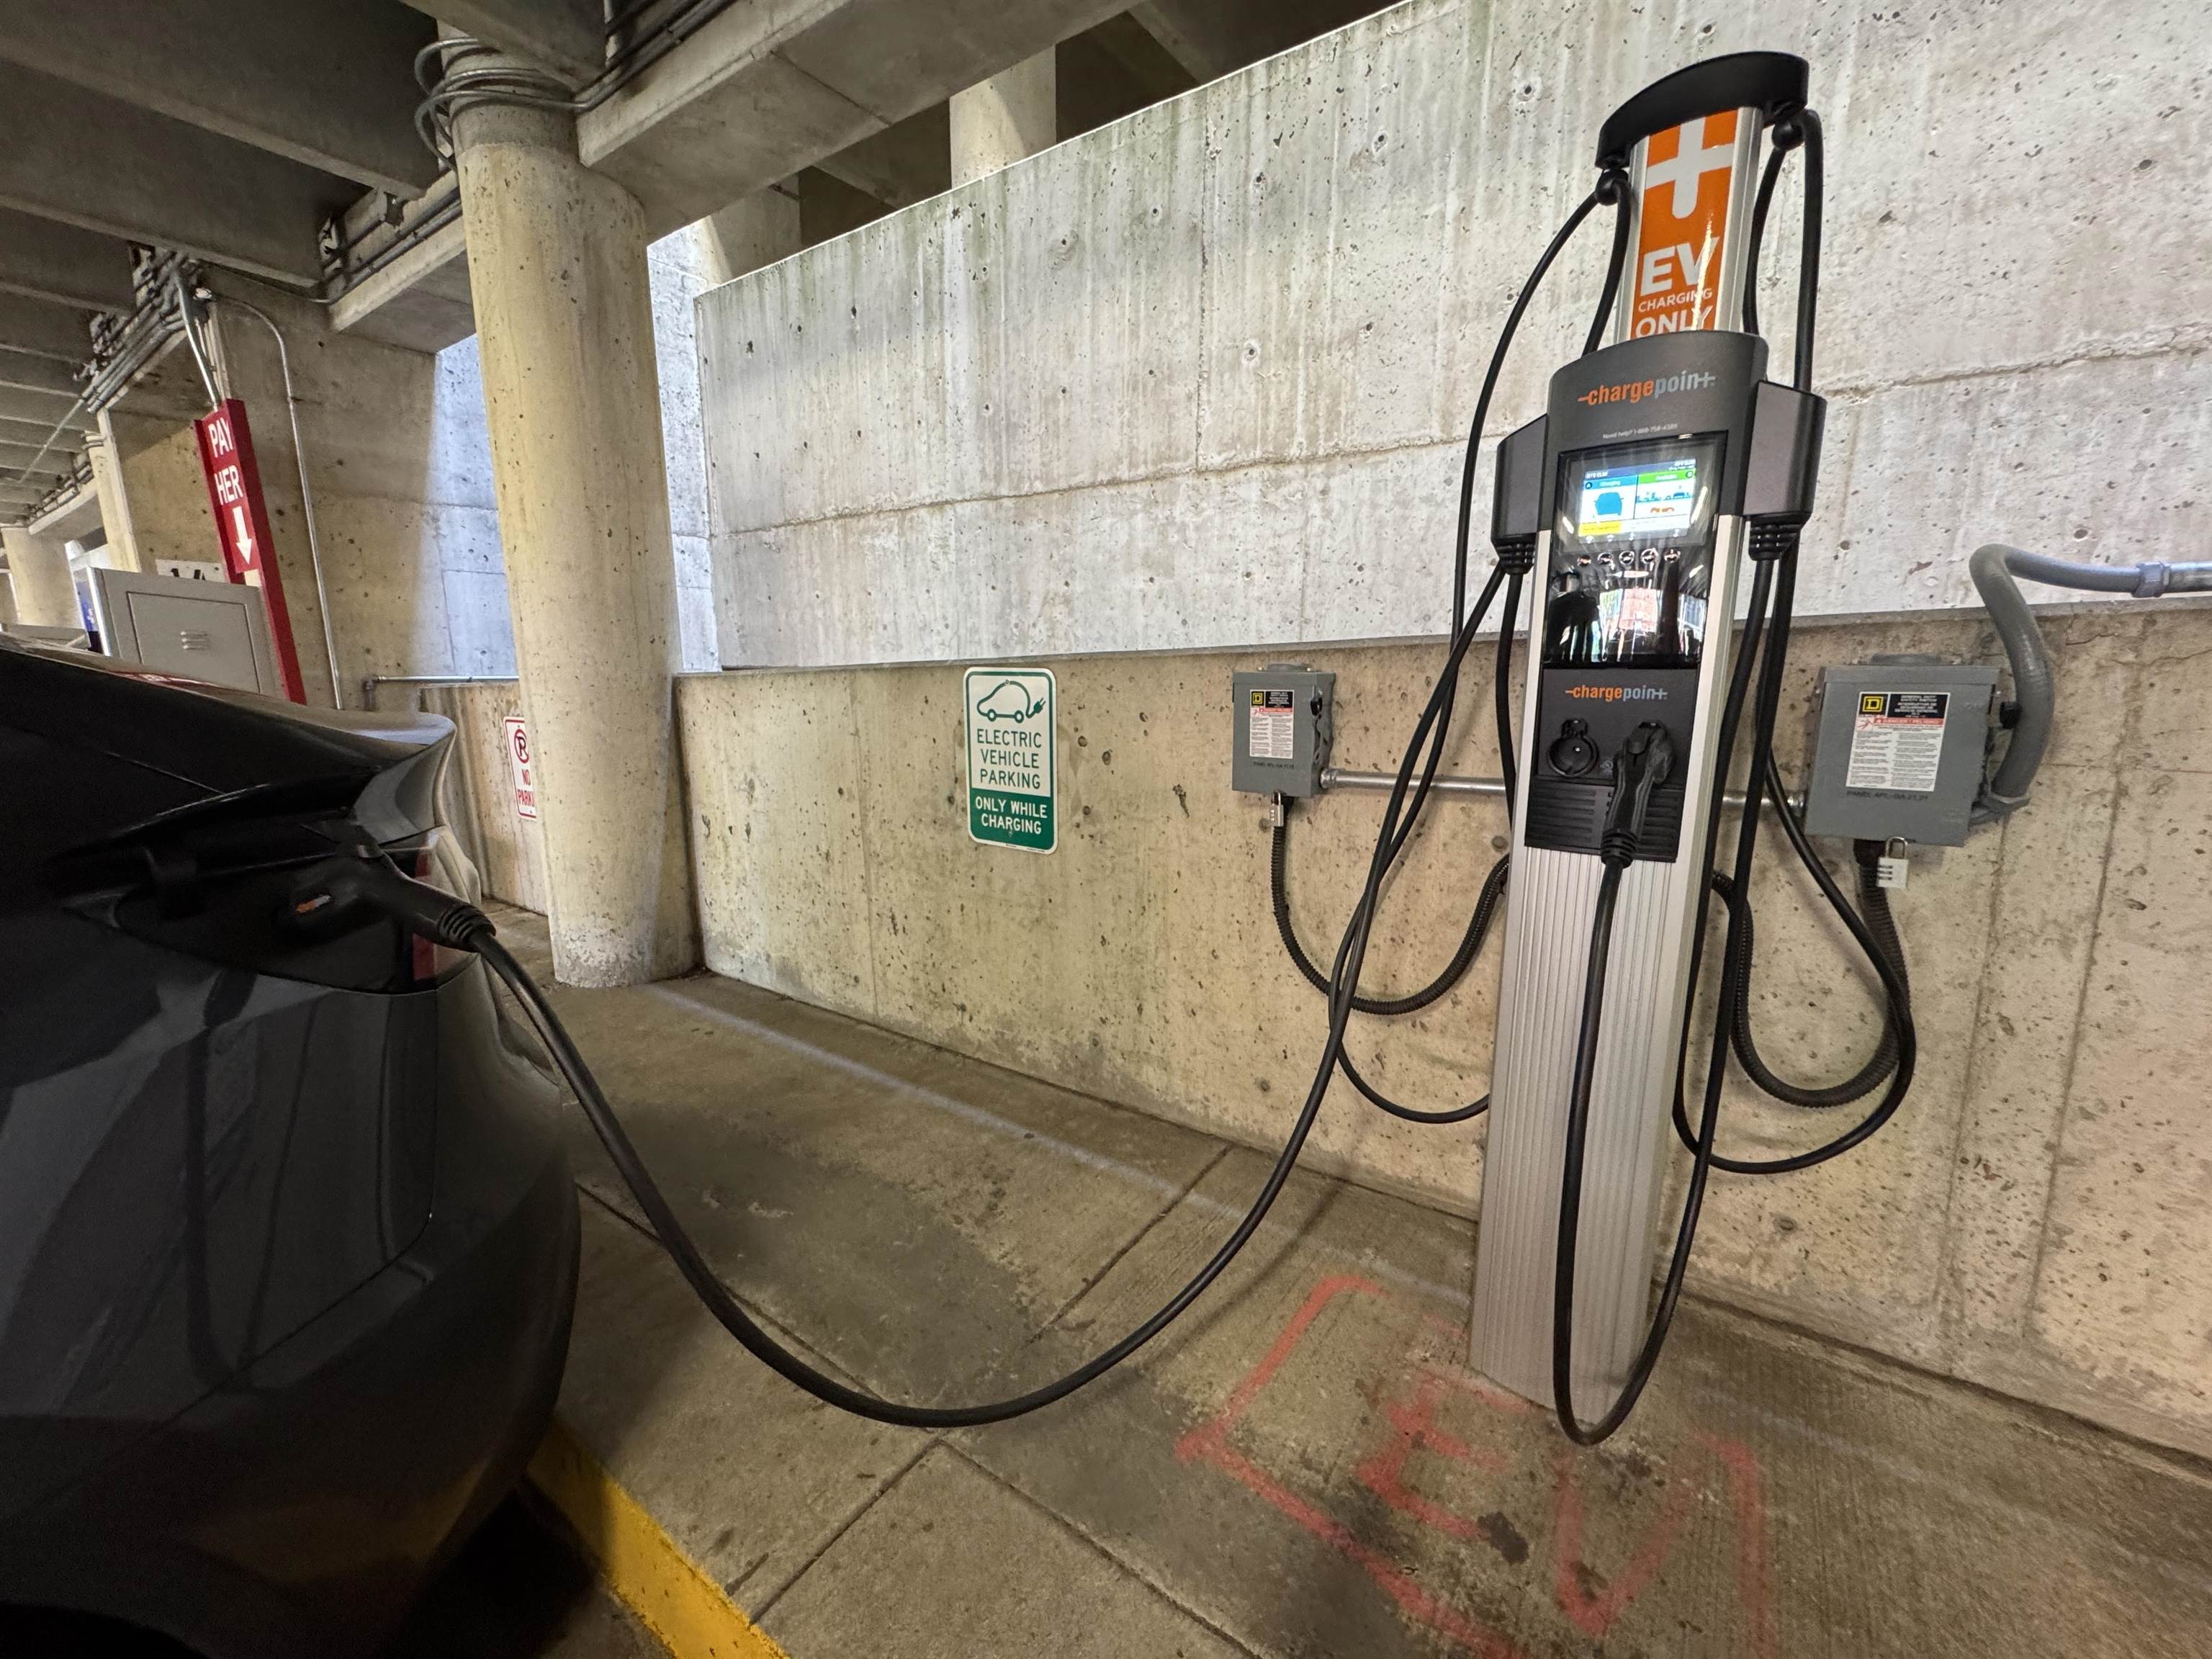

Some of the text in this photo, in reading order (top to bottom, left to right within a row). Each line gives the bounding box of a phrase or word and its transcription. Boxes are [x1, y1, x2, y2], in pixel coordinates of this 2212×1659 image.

[1640, 236, 1720, 297] EV
[1638, 287, 1713, 313] CHARGING
[1635, 305, 1714, 338] ONLY
[207, 417, 234, 458] PAY
[214, 464, 243, 505] HER
[977, 729, 1042, 747] ELECTRIC
[980, 748, 1040, 768] VEHICLE
[522, 769, 531, 786] NO
[980, 768, 1040, 789] PARKING
[517, 788, 535, 807] PARKI
[975, 796, 1048, 819] ONLY WHILE
[981, 813, 1042, 835] CHARGING
